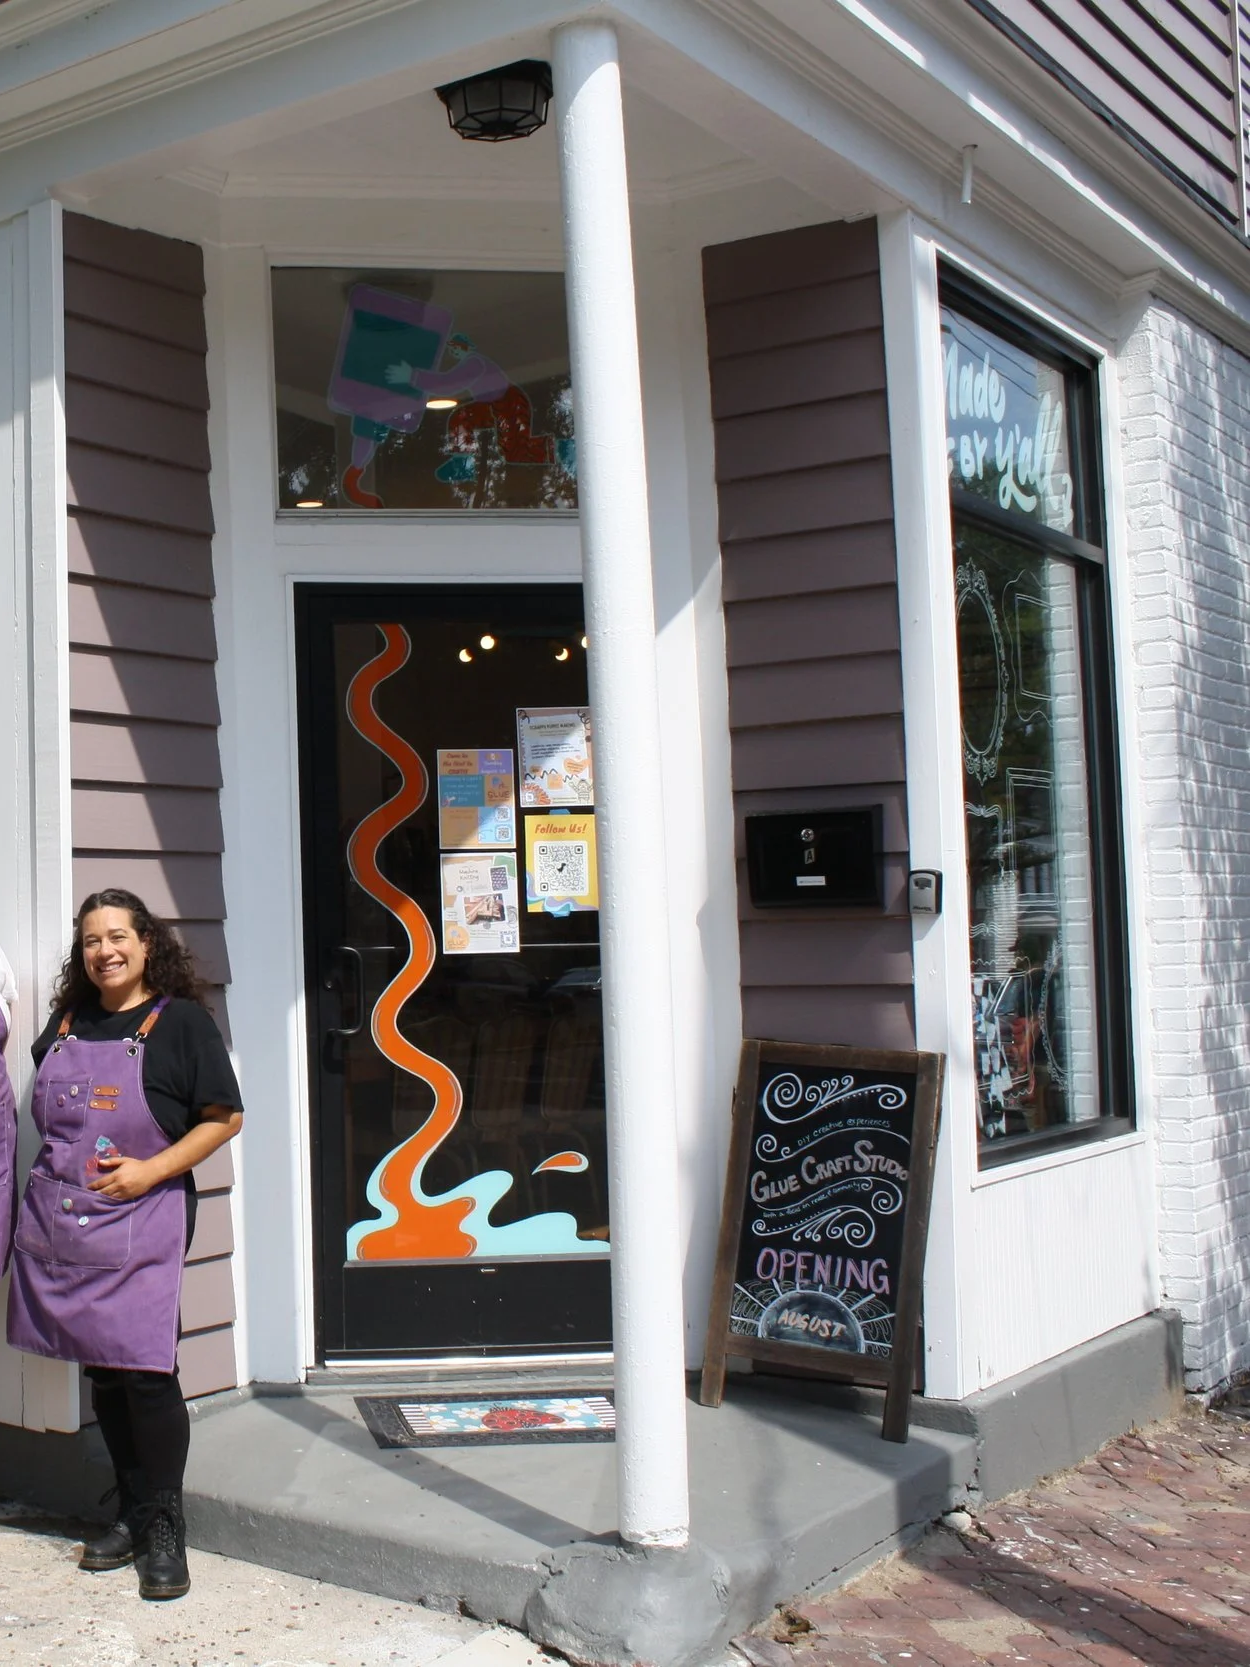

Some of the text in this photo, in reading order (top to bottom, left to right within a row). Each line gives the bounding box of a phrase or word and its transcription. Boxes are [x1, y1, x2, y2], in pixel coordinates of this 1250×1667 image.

[535, 823, 587, 834] Follow Us!
[797, 1135, 810, 1146] DIY
[813, 1120, 844, 1137] creative
[756, 1247, 890, 1295] OPENING
[778, 1308, 847, 1338] AUGUST
